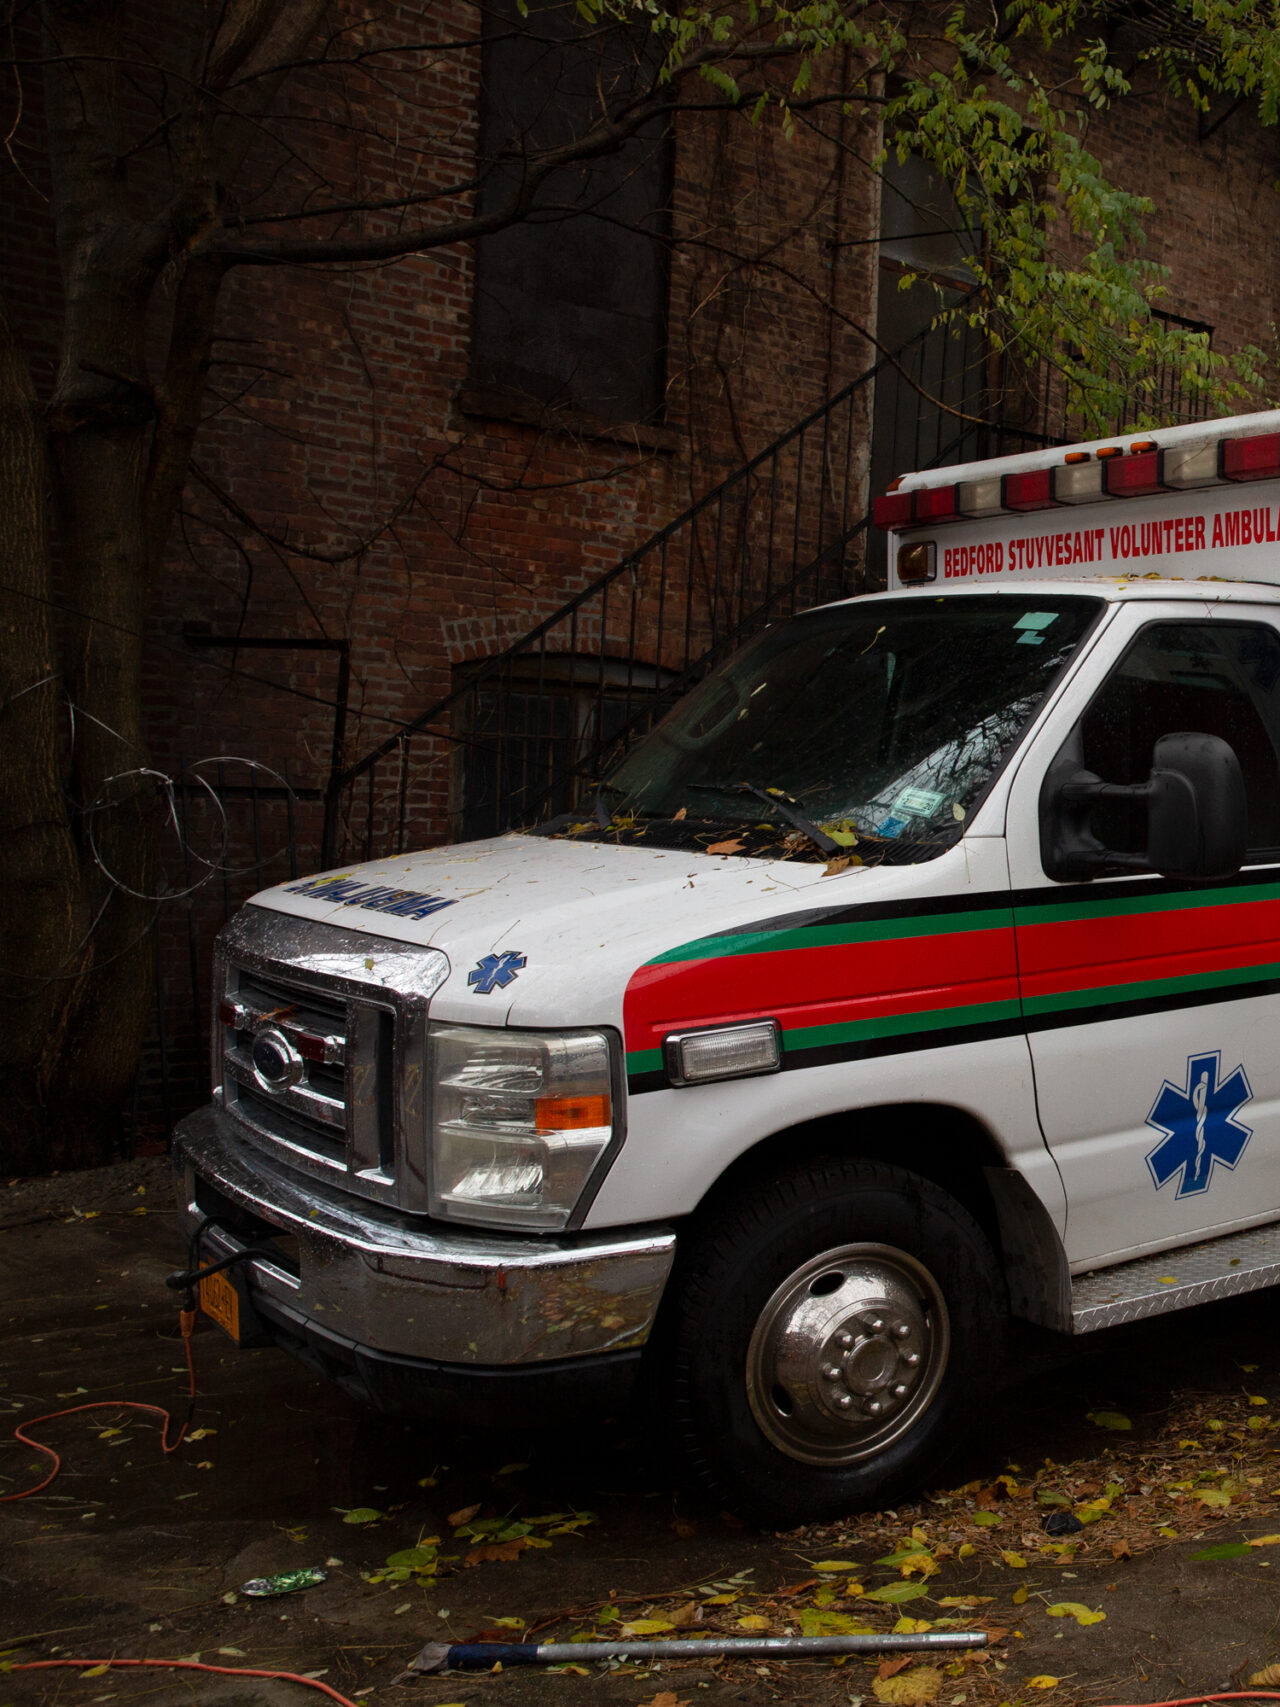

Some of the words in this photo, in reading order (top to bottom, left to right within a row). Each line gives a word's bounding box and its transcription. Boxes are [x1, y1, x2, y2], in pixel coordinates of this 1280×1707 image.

[944, 541, 1004, 579] BEDFORD
[1008, 528, 1105, 571] STUYVESANT
[1110, 515, 1206, 560] VOLUNTEER
